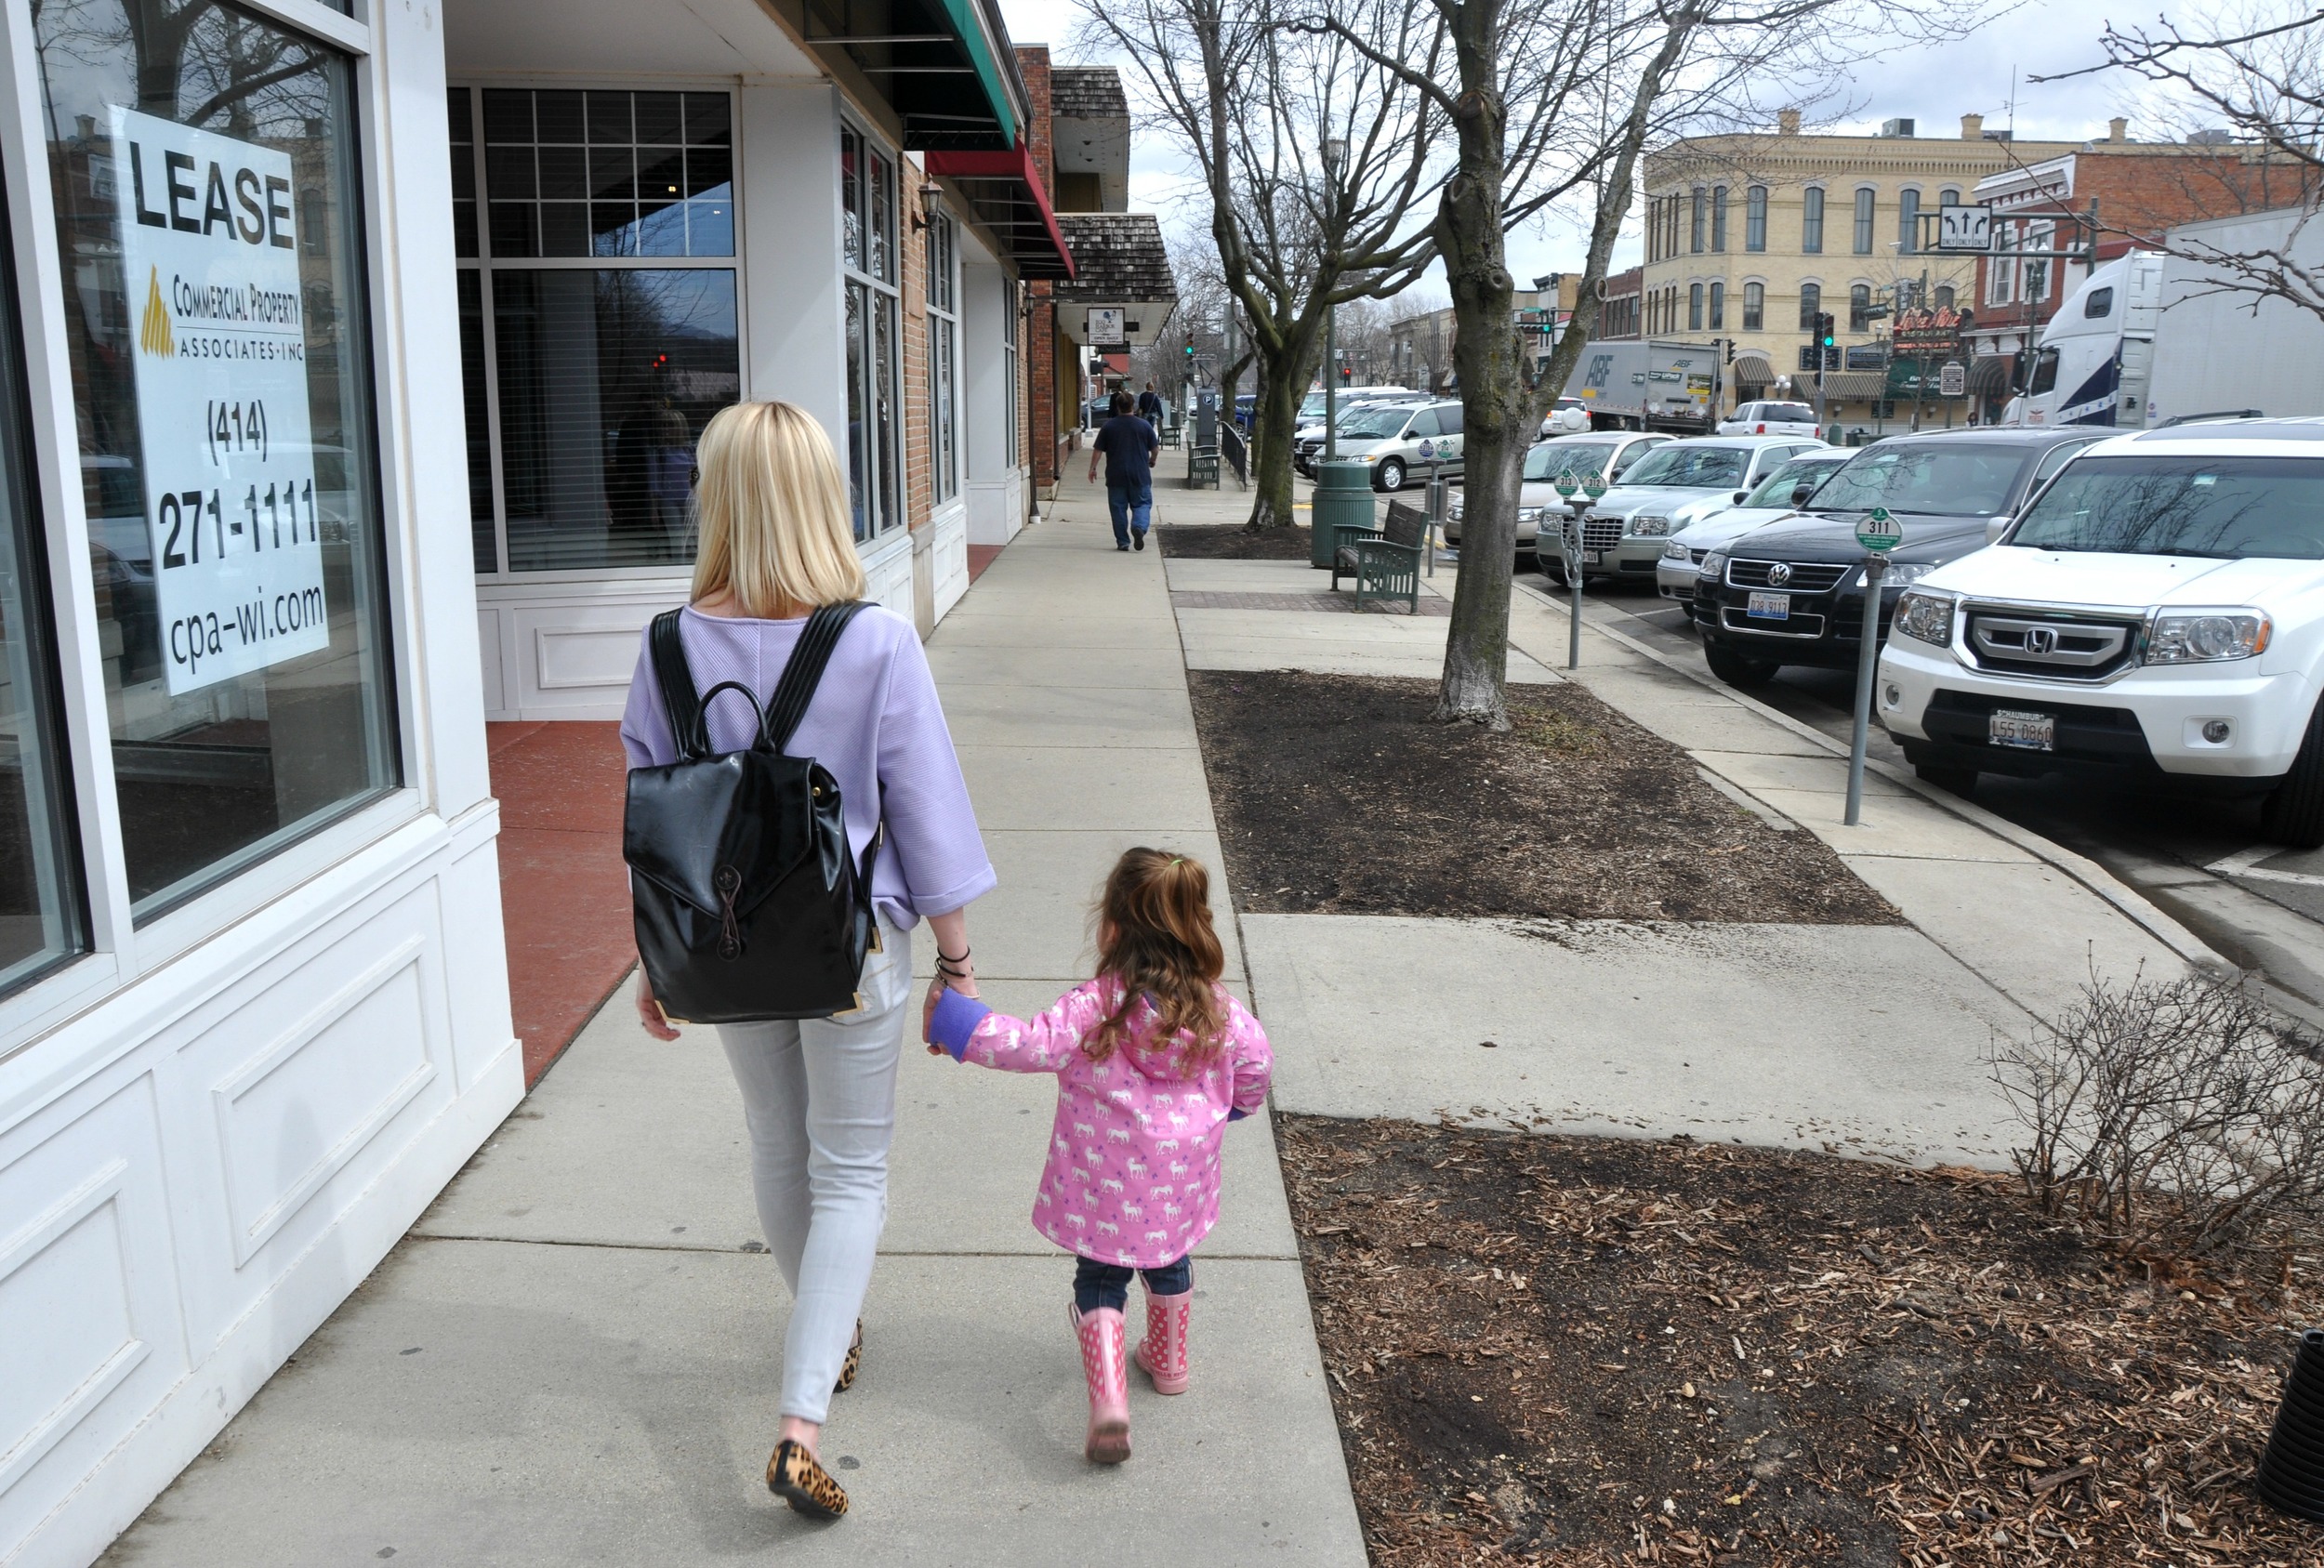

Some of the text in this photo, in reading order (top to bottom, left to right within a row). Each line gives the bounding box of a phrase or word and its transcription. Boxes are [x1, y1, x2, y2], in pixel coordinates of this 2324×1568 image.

[129, 140, 294, 250] LEASE
[174, 273, 298, 324] COMMERCIAL PROPERTY
[1585, 355, 1614, 387] ABF
[1672, 359, 1694, 368] ABF
[207, 400, 268, 467] (414)
[1561, 477, 1572, 486] 313
[1589, 479, 1601, 487] 312
[159, 479, 316, 570] 271-1111
[1868, 520, 1889, 534] 311
[171, 586, 324, 675] cpa-wi.com
[1996, 709, 2045, 722] SCHAUMBURG
